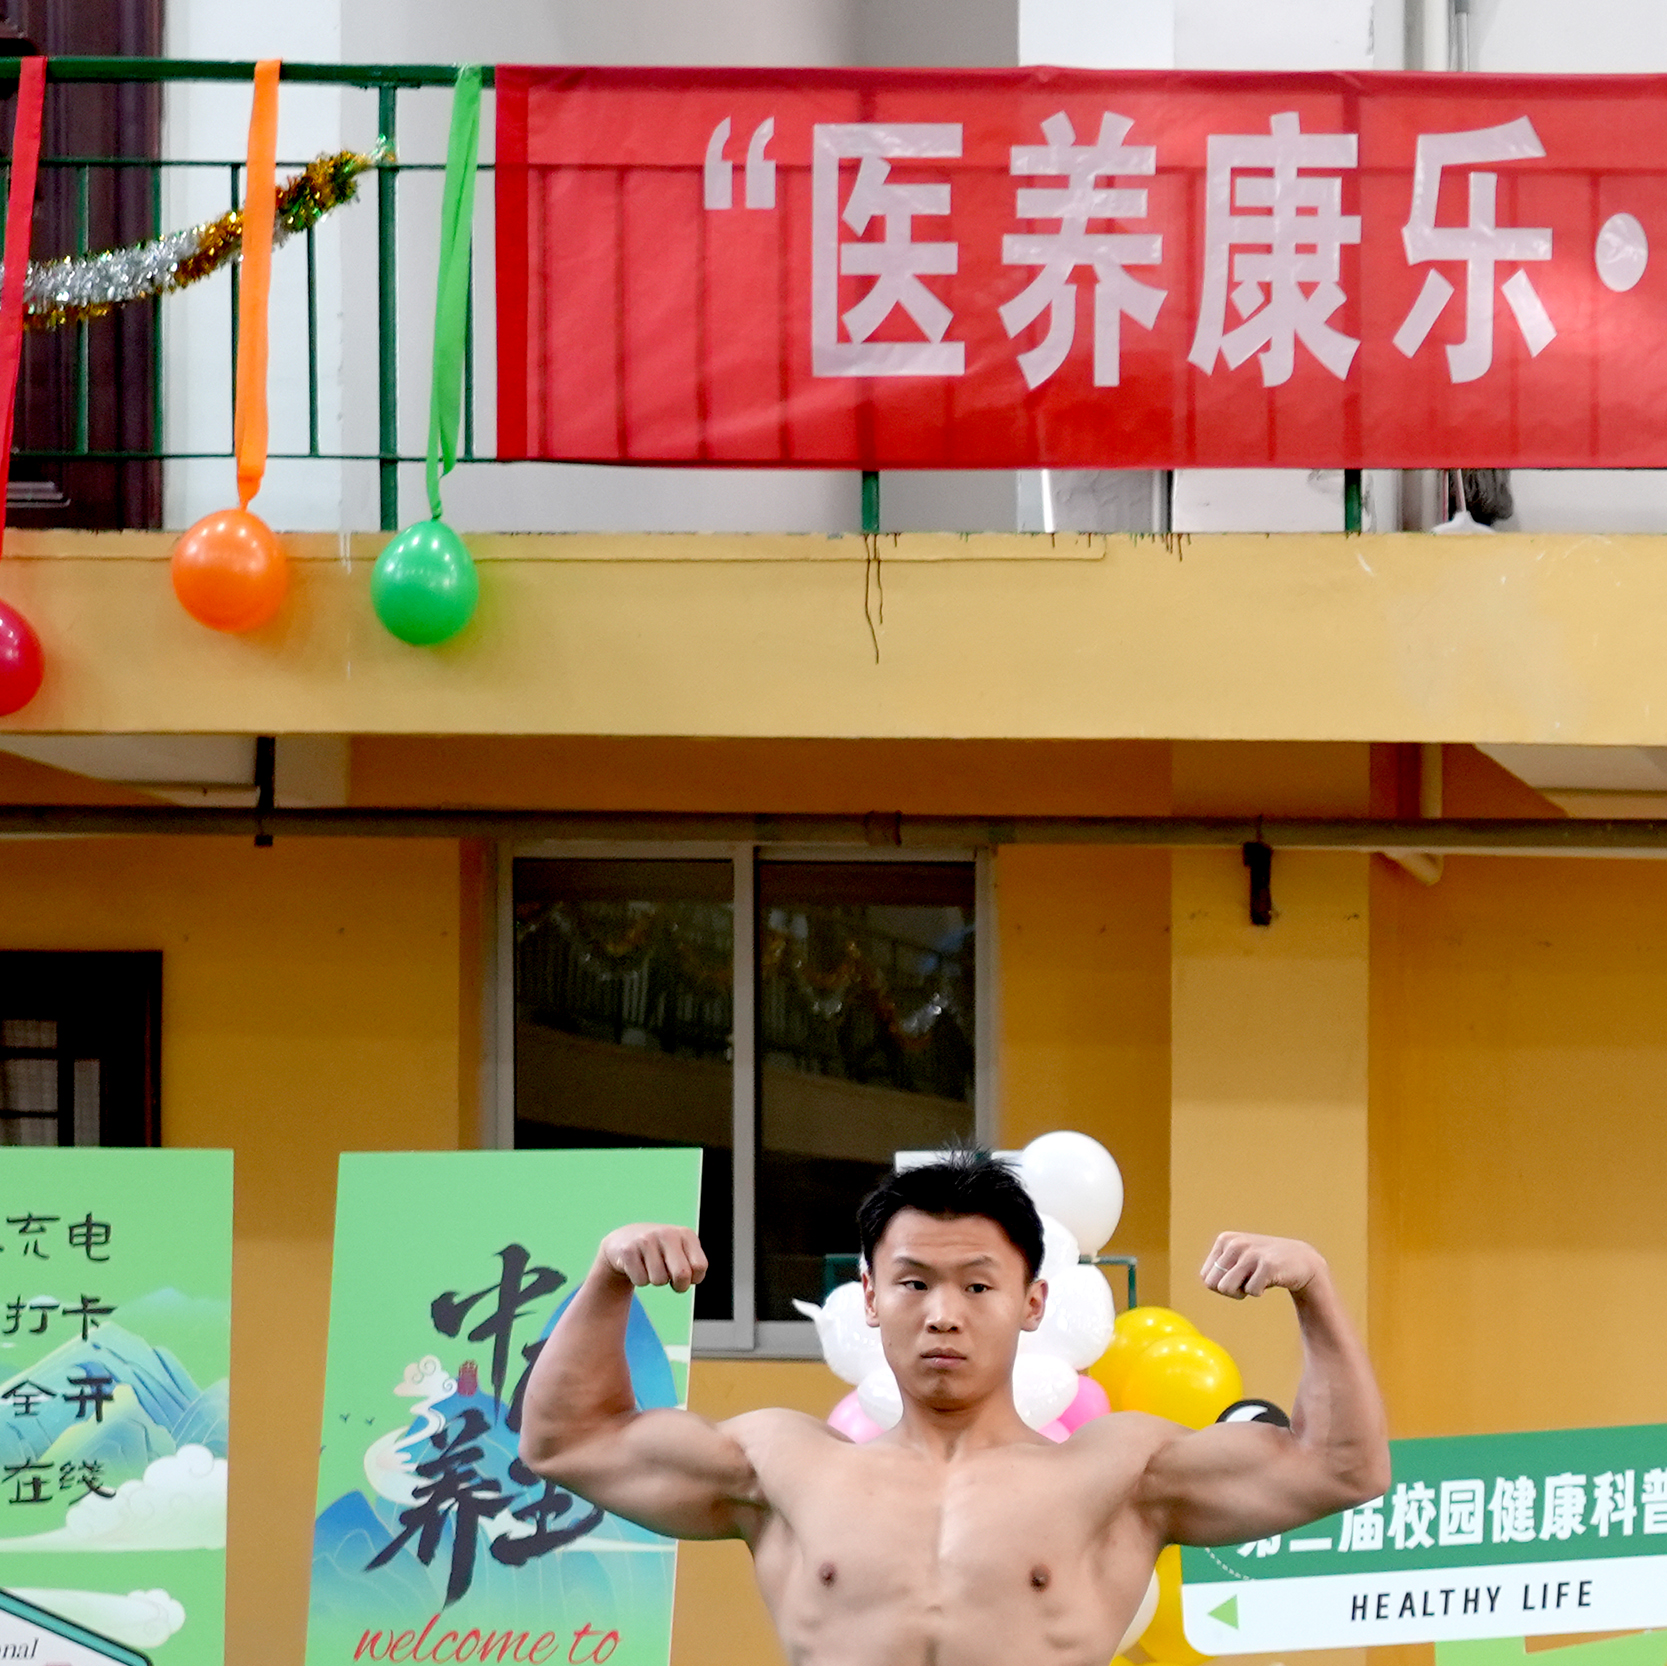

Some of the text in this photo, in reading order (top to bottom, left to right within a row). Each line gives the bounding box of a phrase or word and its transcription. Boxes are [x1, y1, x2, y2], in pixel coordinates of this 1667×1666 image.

[2, 1293, 117, 1342] 打卡
[1, 1379, 115, 1423] 全开
[2, 1458, 117, 1505] 在线
[1350, 1580, 1594, 1622] HEALTHY LIFE
[0, 1638, 39, 1660] nal
[353, 1612, 623, 1665] welcome to
